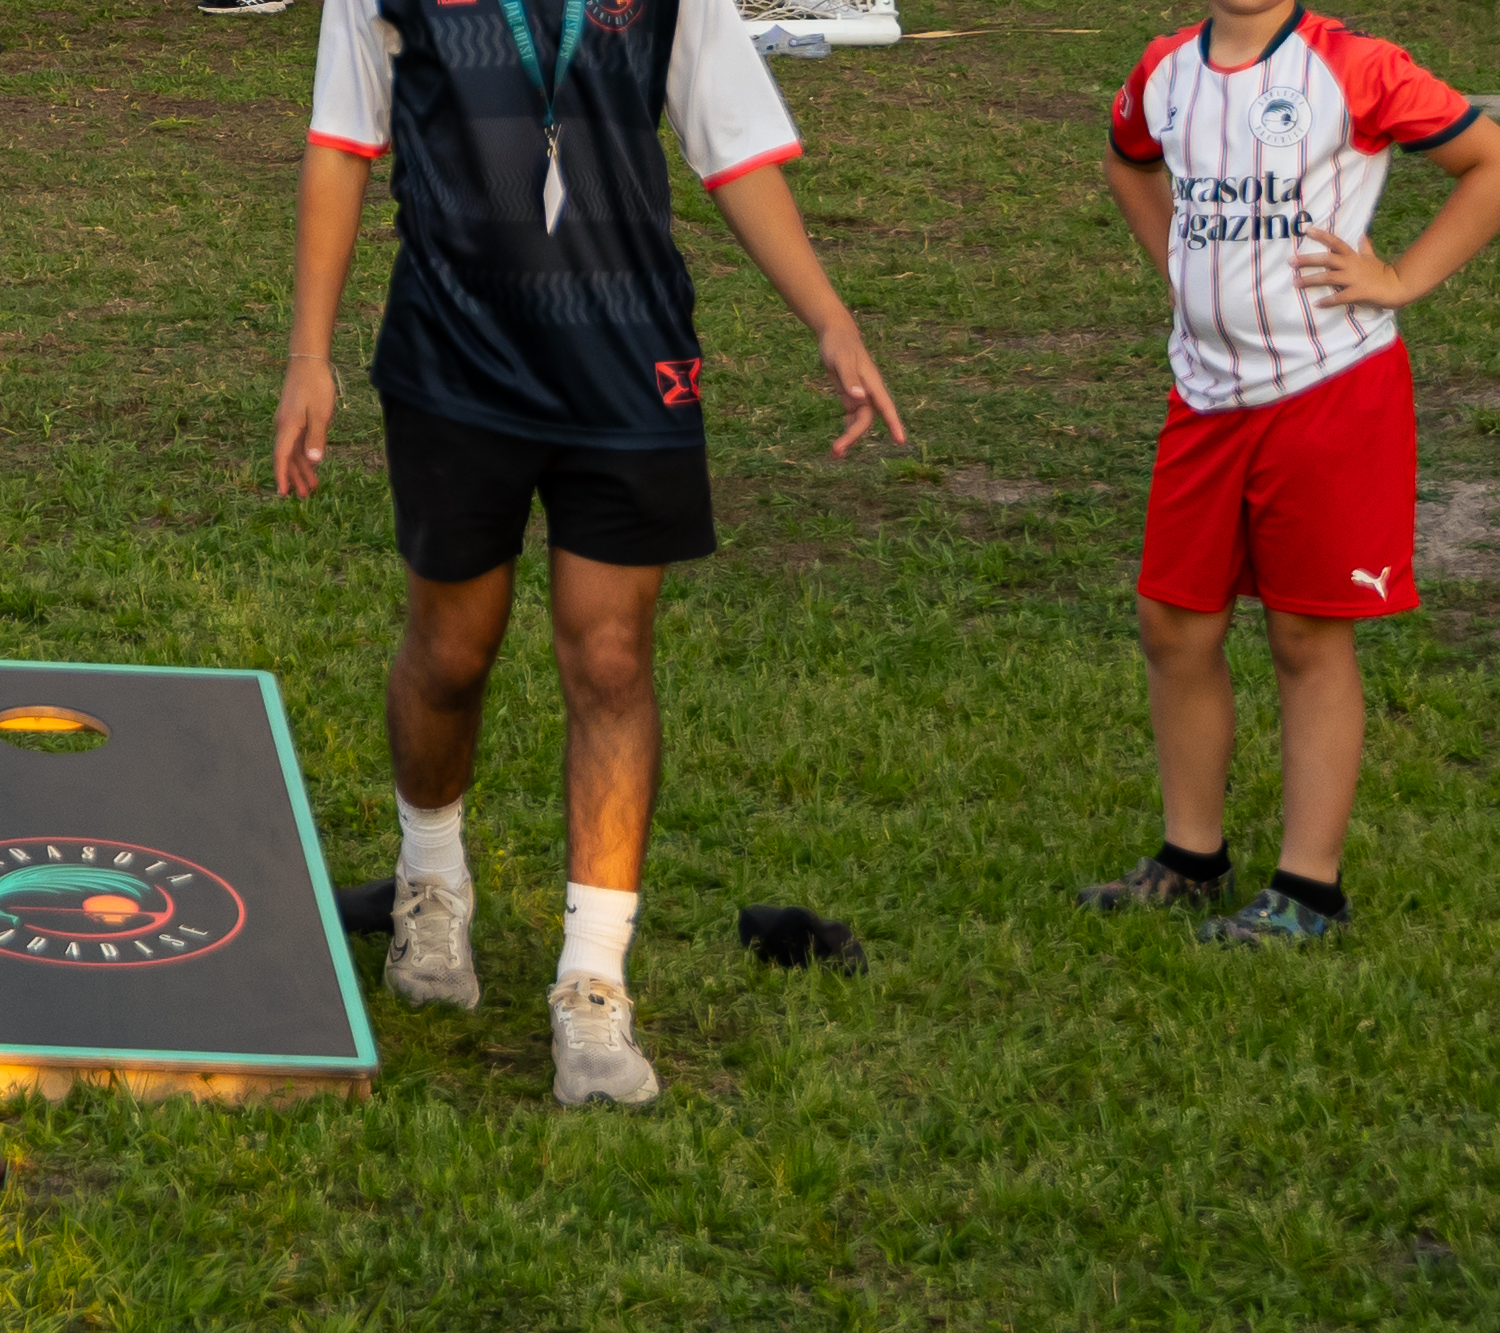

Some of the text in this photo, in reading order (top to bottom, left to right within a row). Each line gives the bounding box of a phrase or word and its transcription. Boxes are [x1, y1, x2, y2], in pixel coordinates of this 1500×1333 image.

[503, 1, 534, 60] PARADISE
[559, 1, 582, 59] SARASOTA
[1175, 206, 1313, 251] agazine
